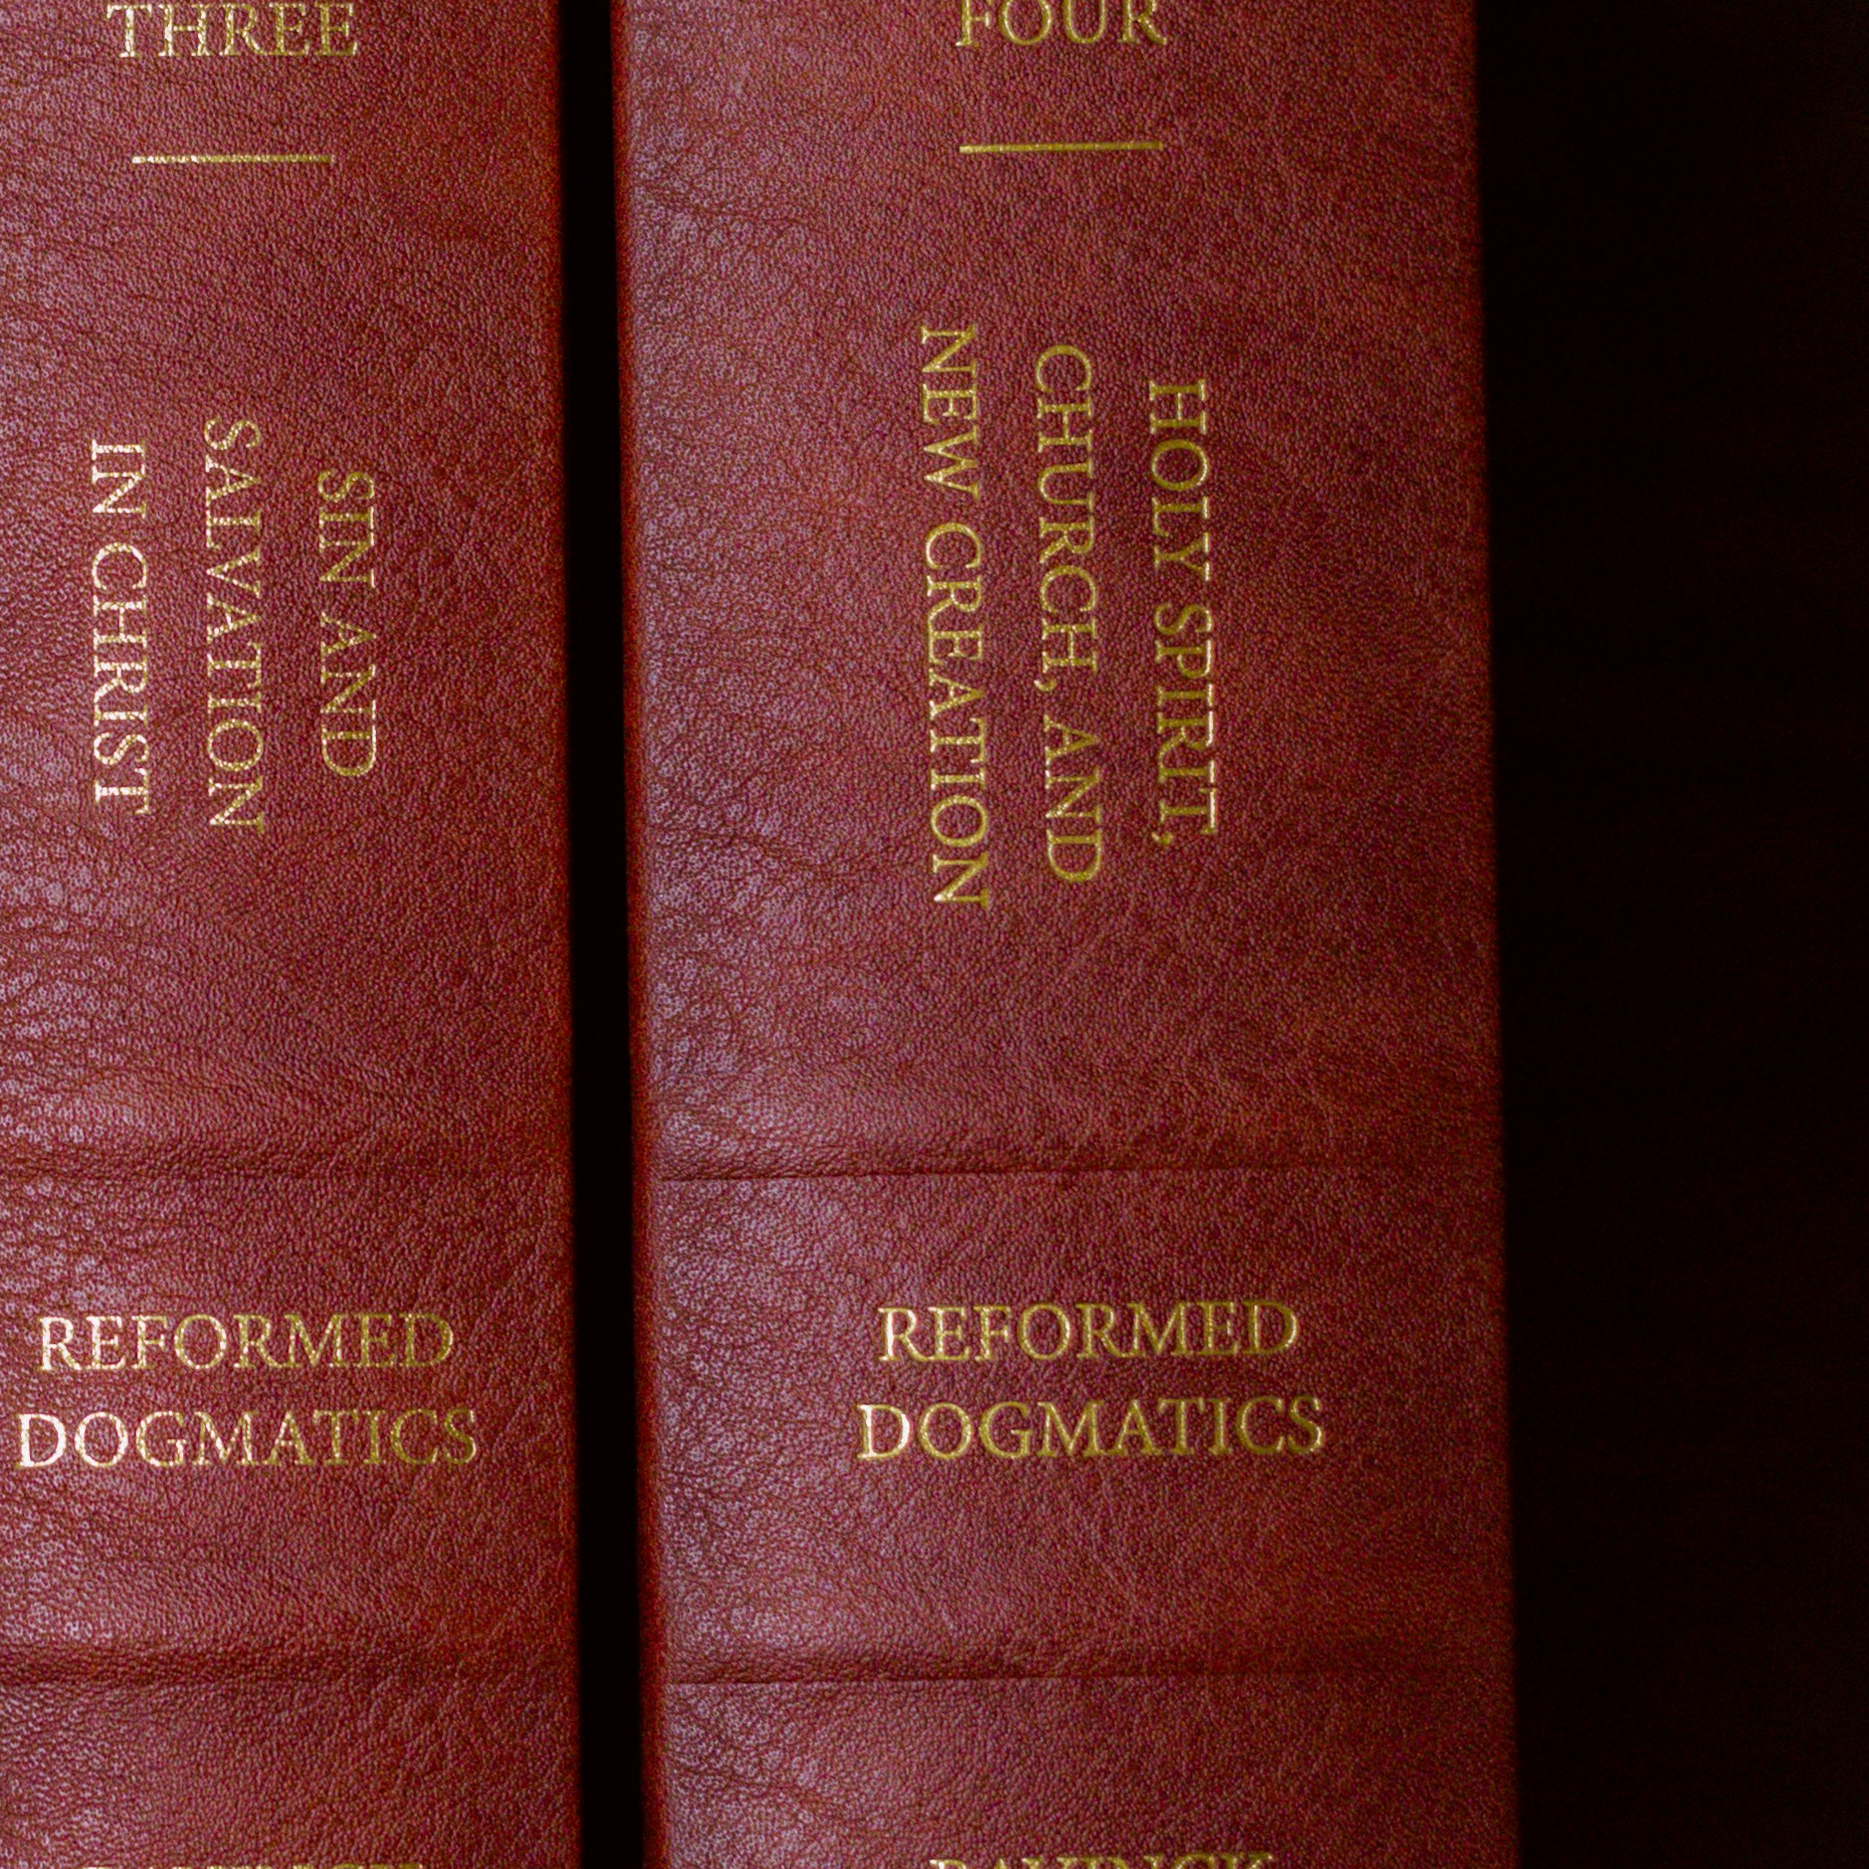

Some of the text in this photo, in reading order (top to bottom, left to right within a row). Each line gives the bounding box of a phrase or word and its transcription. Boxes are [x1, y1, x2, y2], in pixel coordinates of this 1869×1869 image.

[108, 2, 359, 60] THREE
[88, 441, 152, 814] IN CHRIST
[202, 417, 267, 832] SALVATION
[316, 471, 378, 779] SIN AND
[920, 323, 993, 909] NEW CREATION
[1031, 343, 1104, 884] CHURCH, AND
[1146, 378, 1220, 848] HOLY SPIRIT,
[16, 1408, 479, 1470] DOGMATICS
[36, 1312, 457, 1373] REFORMED
[856, 1397, 1327, 1463] DOGMATICS
[876, 1301, 1300, 1363] REFORMED
